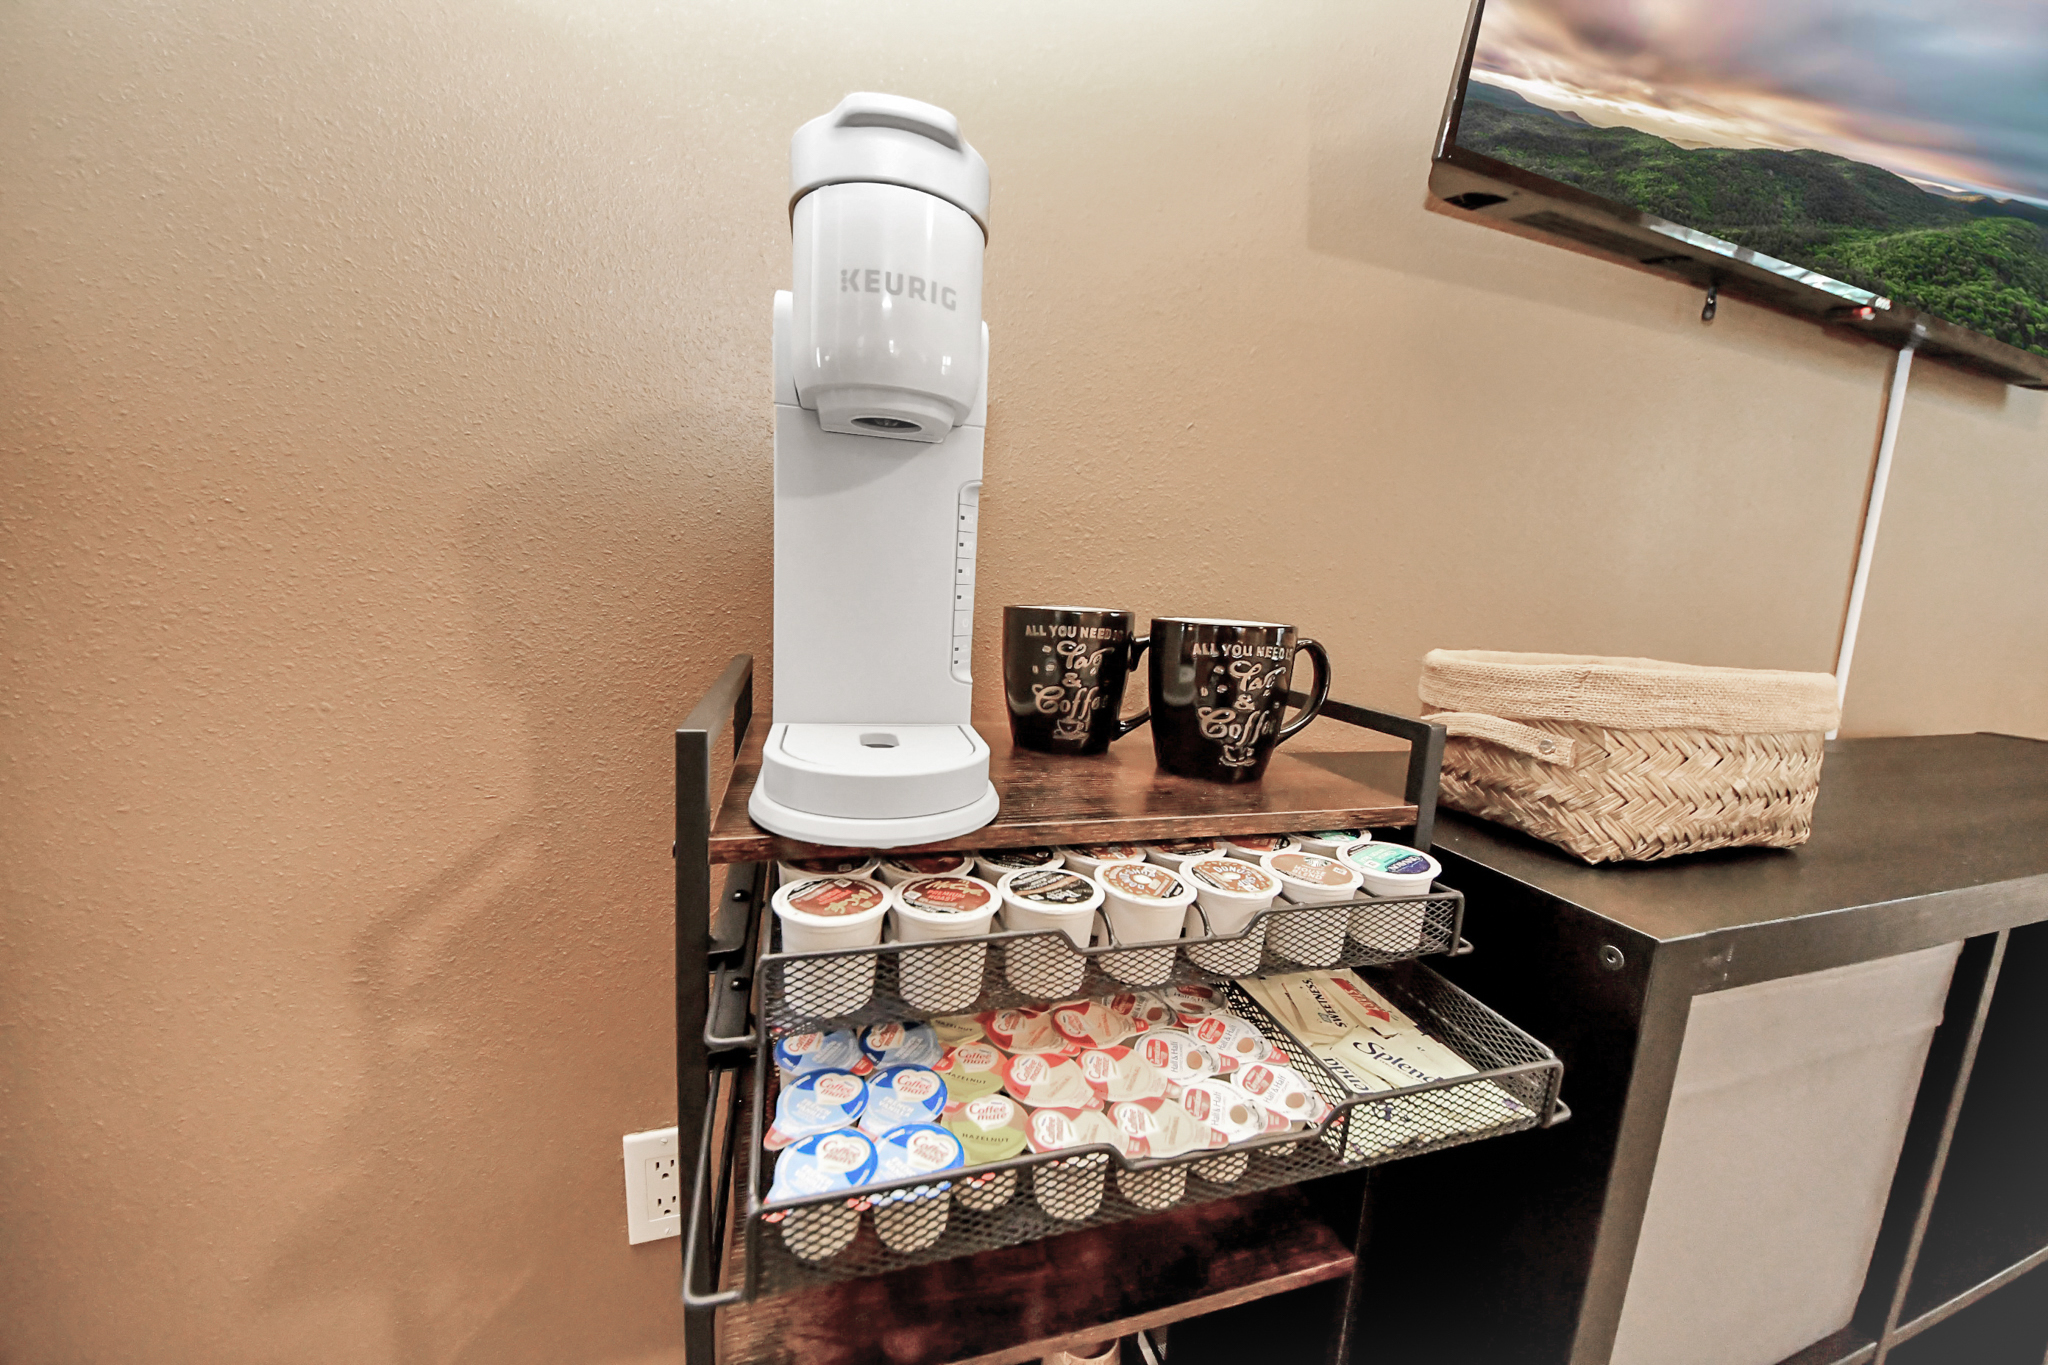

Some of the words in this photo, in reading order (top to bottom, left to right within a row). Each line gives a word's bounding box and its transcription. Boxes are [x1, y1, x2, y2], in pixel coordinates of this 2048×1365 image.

[840, 268, 957, 311] KEURIG
[1025, 625, 1046, 637] ALL
[1049, 625, 1077, 638] YOU
[1080, 626, 1111, 640] NEED
[1193, 642, 1219, 658] ALL
[1222, 643, 1253, 659] YOU
[1256, 645, 1285, 661] NEED
[1291, 868, 1323, 881] BLEND
[1294, 864, 1327, 877] HOUSE
[935, 1019, 973, 1032] HAZELNUT
[957, 1048, 992, 1060] Coffee
[1016, 1059, 1038, 1082] Coffee
[1088, 1055, 1103, 1079] Coffee
[1352, 1042, 1445, 1083] Splend
[1029, 1063, 1044, 1083] mate
[819, 1077, 854, 1093] Coffee
[897, 1074, 932, 1091] Coffee
[899, 1085, 931, 1095] mate
[969, 1103, 1007, 1116] Coffee
[977, 1111, 1008, 1121] mate
[962, 1133, 1009, 1143] HAZELNUT
[822, 1140, 861, 1159] Coffee
[913, 1136, 949, 1159] Coffee
